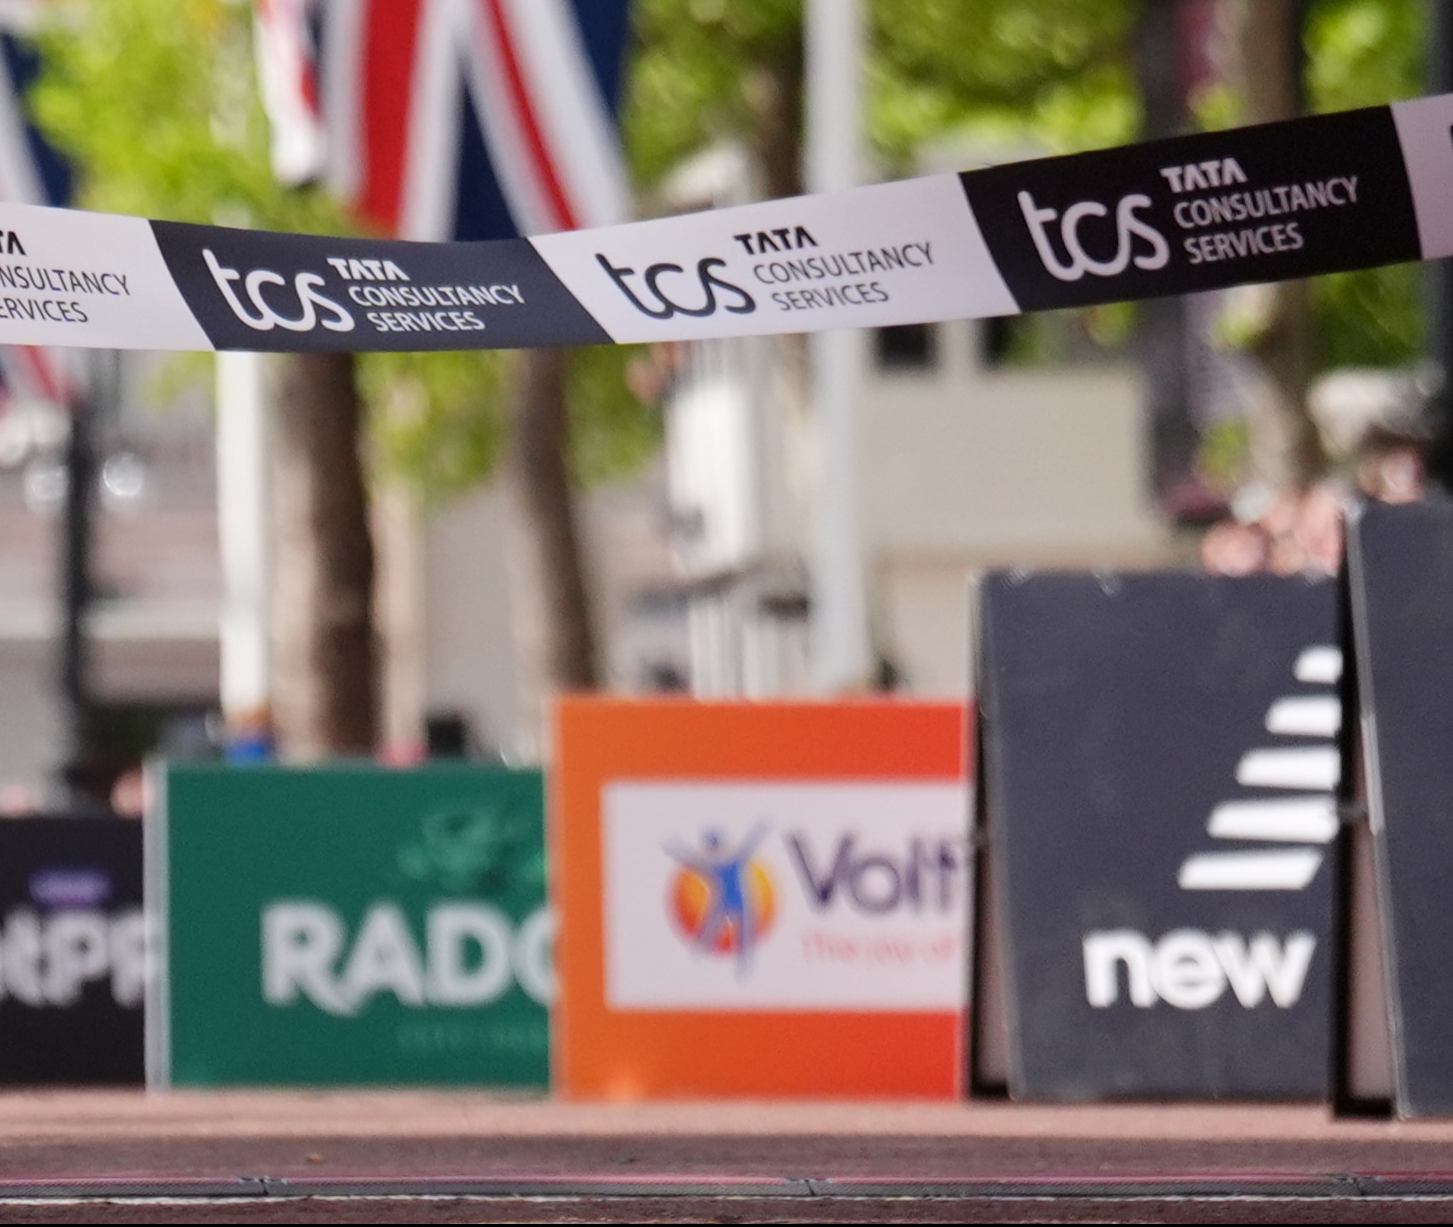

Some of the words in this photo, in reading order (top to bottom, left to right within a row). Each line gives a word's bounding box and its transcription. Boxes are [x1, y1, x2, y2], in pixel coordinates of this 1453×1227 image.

[1160, 157, 1247, 193] TATA
[1172, 176, 1360, 230] CONSULTANCY
[734, 226, 818, 256] TATA
[1017, 190, 1170, 282] tcs
[1184, 222, 1304, 265] SERVICES
[327, 258, 411, 282] TATA
[753, 241, 934, 285] CONSULTANCY
[202, 249, 353, 333] tcs
[348, 283, 525, 309] CONSULTANCY
[595, 253, 757, 320] tcs
[772, 281, 889, 313] SERVICES
[366, 310, 486, 333] SERVICES
[1082, 927, 1316, 1010] new
